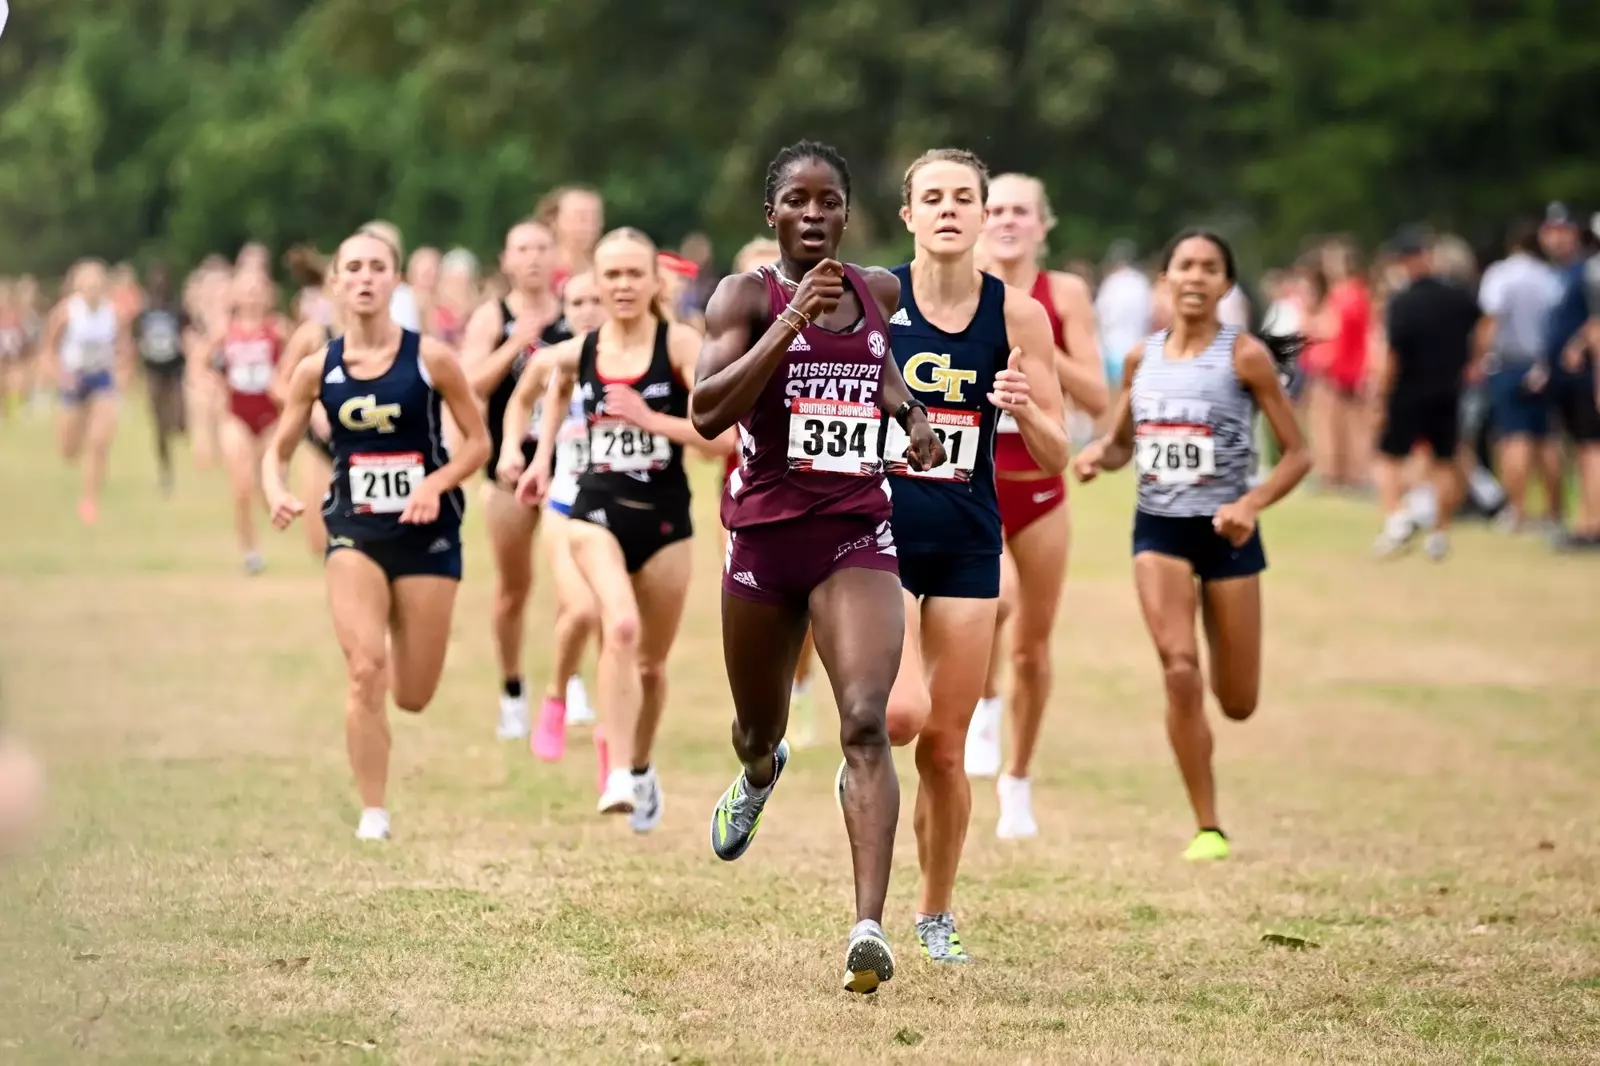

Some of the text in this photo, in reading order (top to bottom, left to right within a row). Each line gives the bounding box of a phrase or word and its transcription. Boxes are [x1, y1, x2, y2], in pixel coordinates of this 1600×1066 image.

[786, 344, 811, 352] didas
[788, 362, 881, 380] MISSISSIPPI
[903, 352, 977, 402] GT
[784, 378, 878, 408] STATE
[338, 394, 402, 434] GT
[799, 403, 875, 418] SOUTHERN SHOWCASE
[936, 413, 975, 426] SHOWCASE
[604, 430, 655, 456] 289
[803, 419, 868, 458] 334
[1150, 443, 1200, 469] 269
[363, 470, 411, 499] 216
